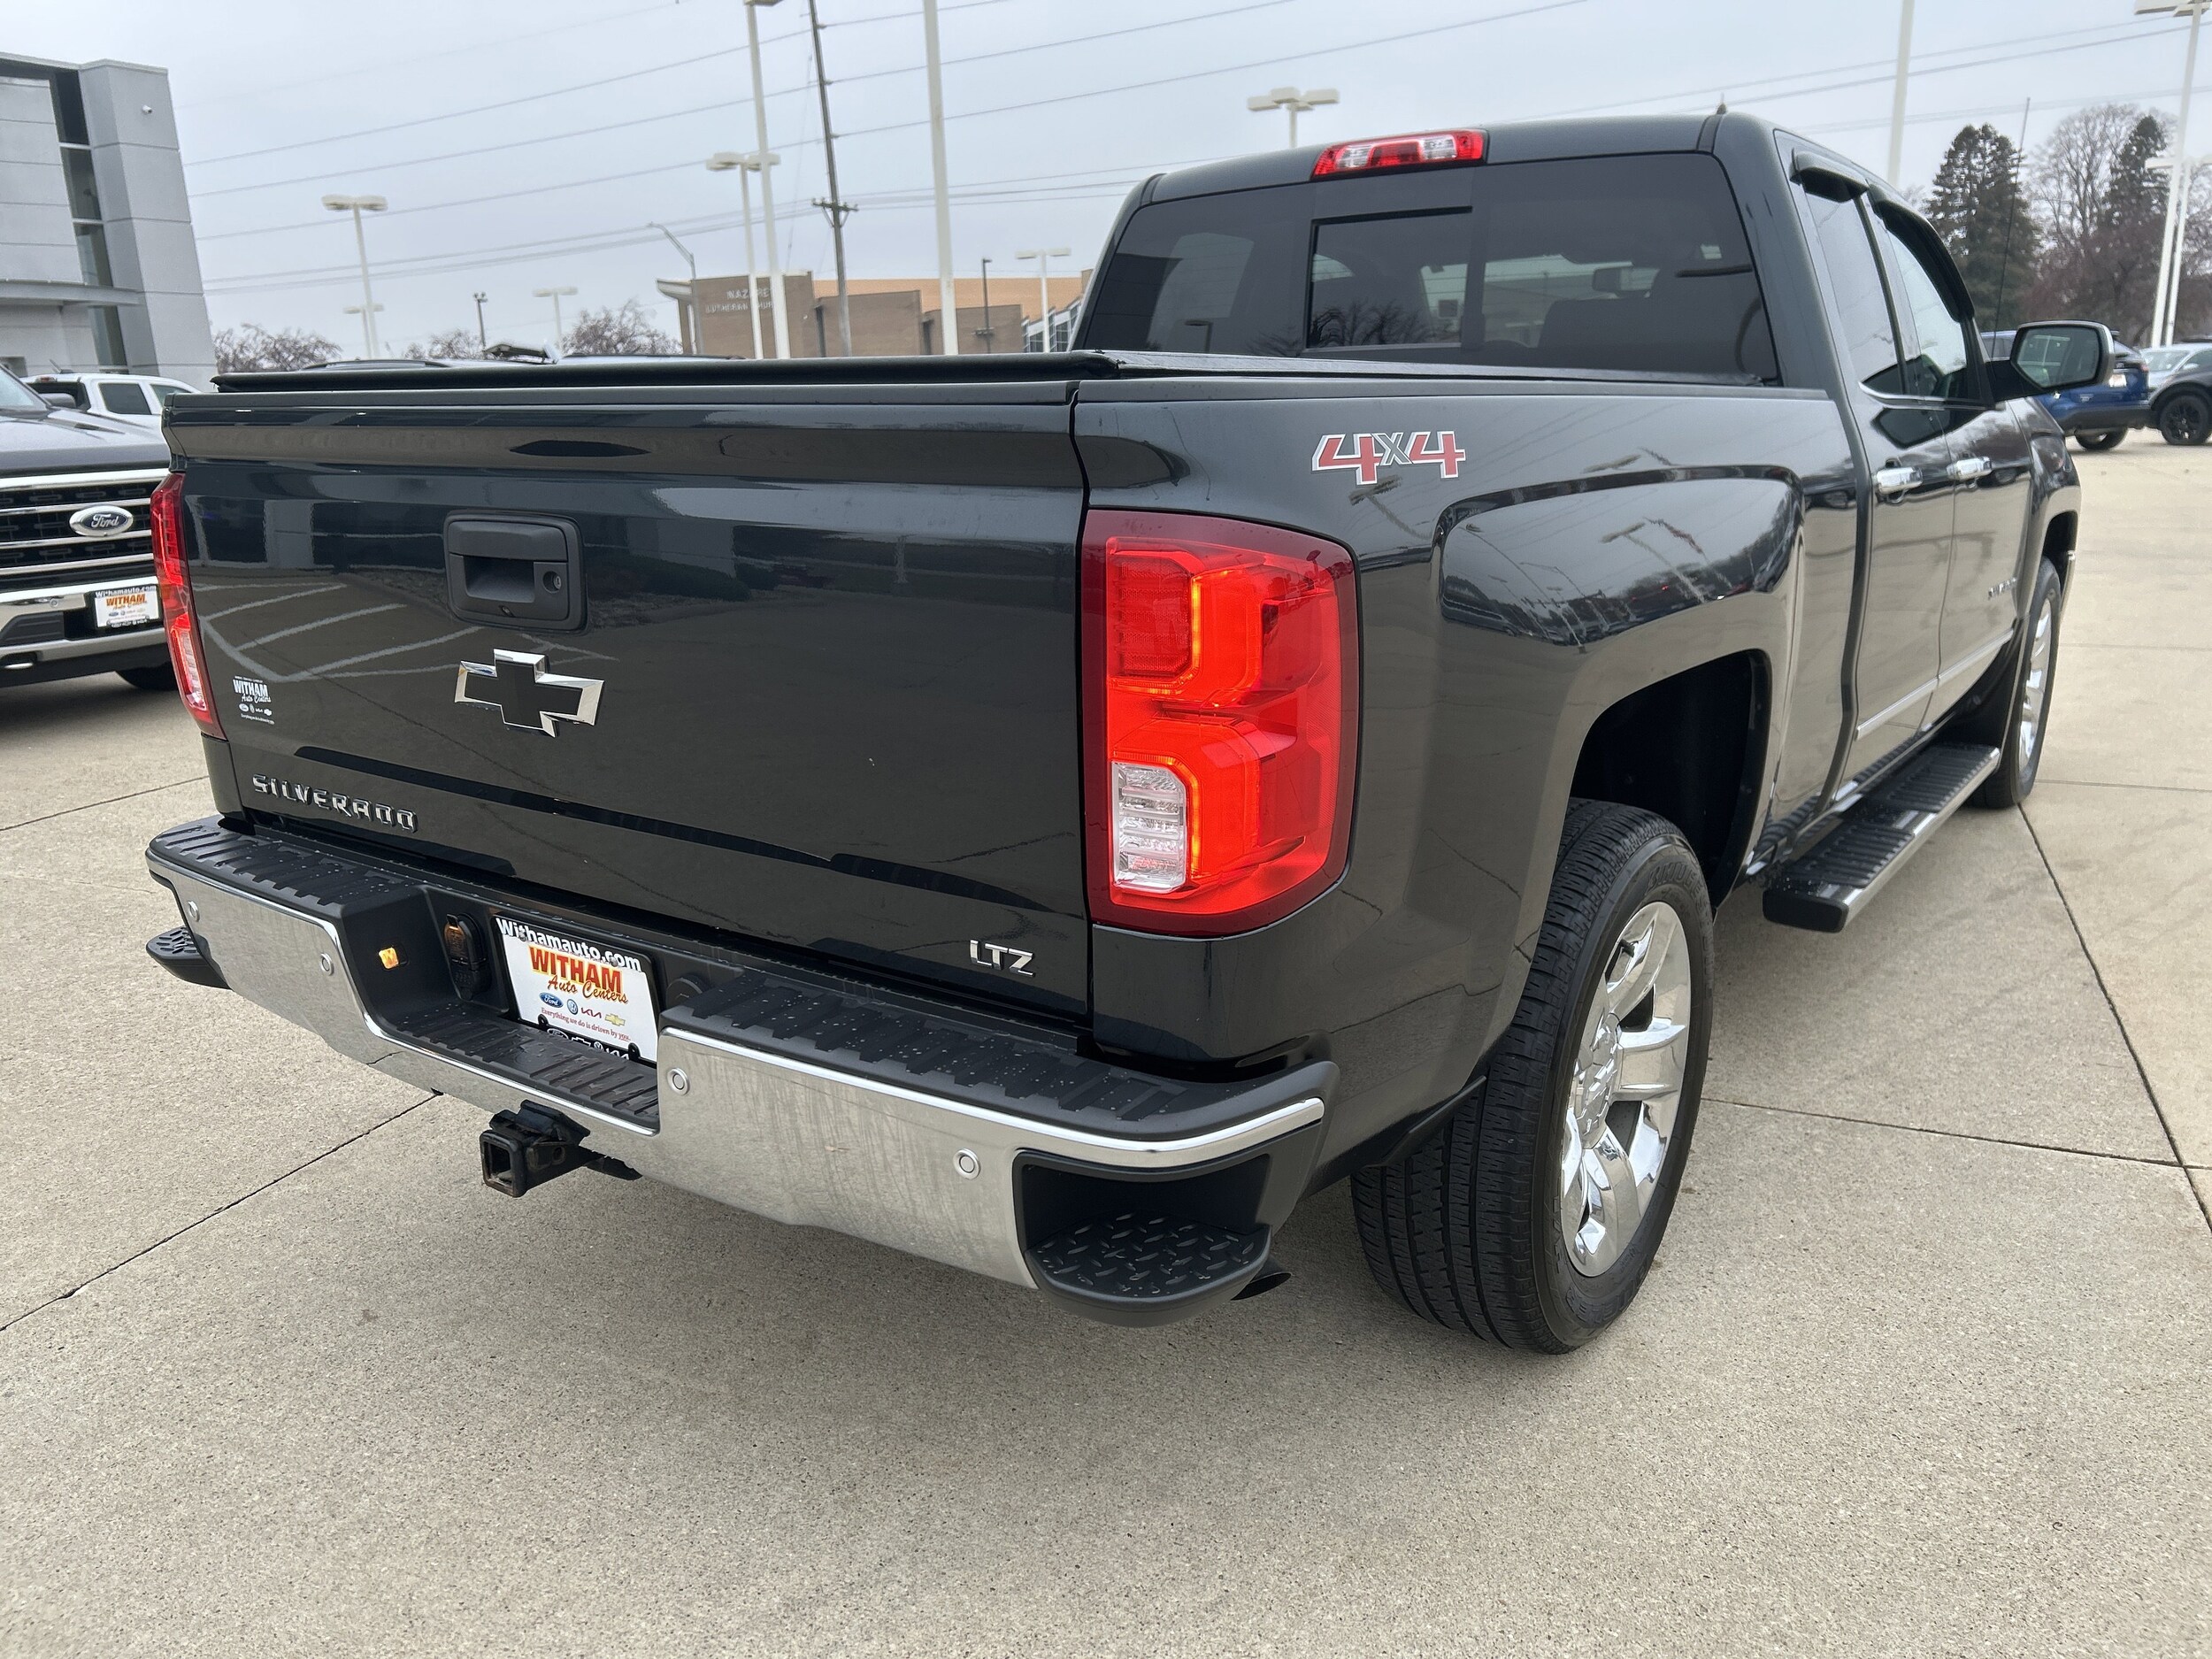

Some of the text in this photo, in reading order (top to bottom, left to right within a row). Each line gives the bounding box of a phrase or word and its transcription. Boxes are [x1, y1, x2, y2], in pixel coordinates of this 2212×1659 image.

[90, 513, 119, 528] Ford
[106, 594, 145, 606] WITHAM
[233, 679, 269, 697] WITHAM
[252, 773, 418, 833] SILVERADO
[529, 946, 621, 994] WITHAM
[970, 940, 1033, 976] LTZ
[547, 974, 629, 1004] Auto Centers
[541, 1007, 570, 1024] Everything
[591, 1024, 610, 1035] driven
[611, 1029, 618, 1039] by
